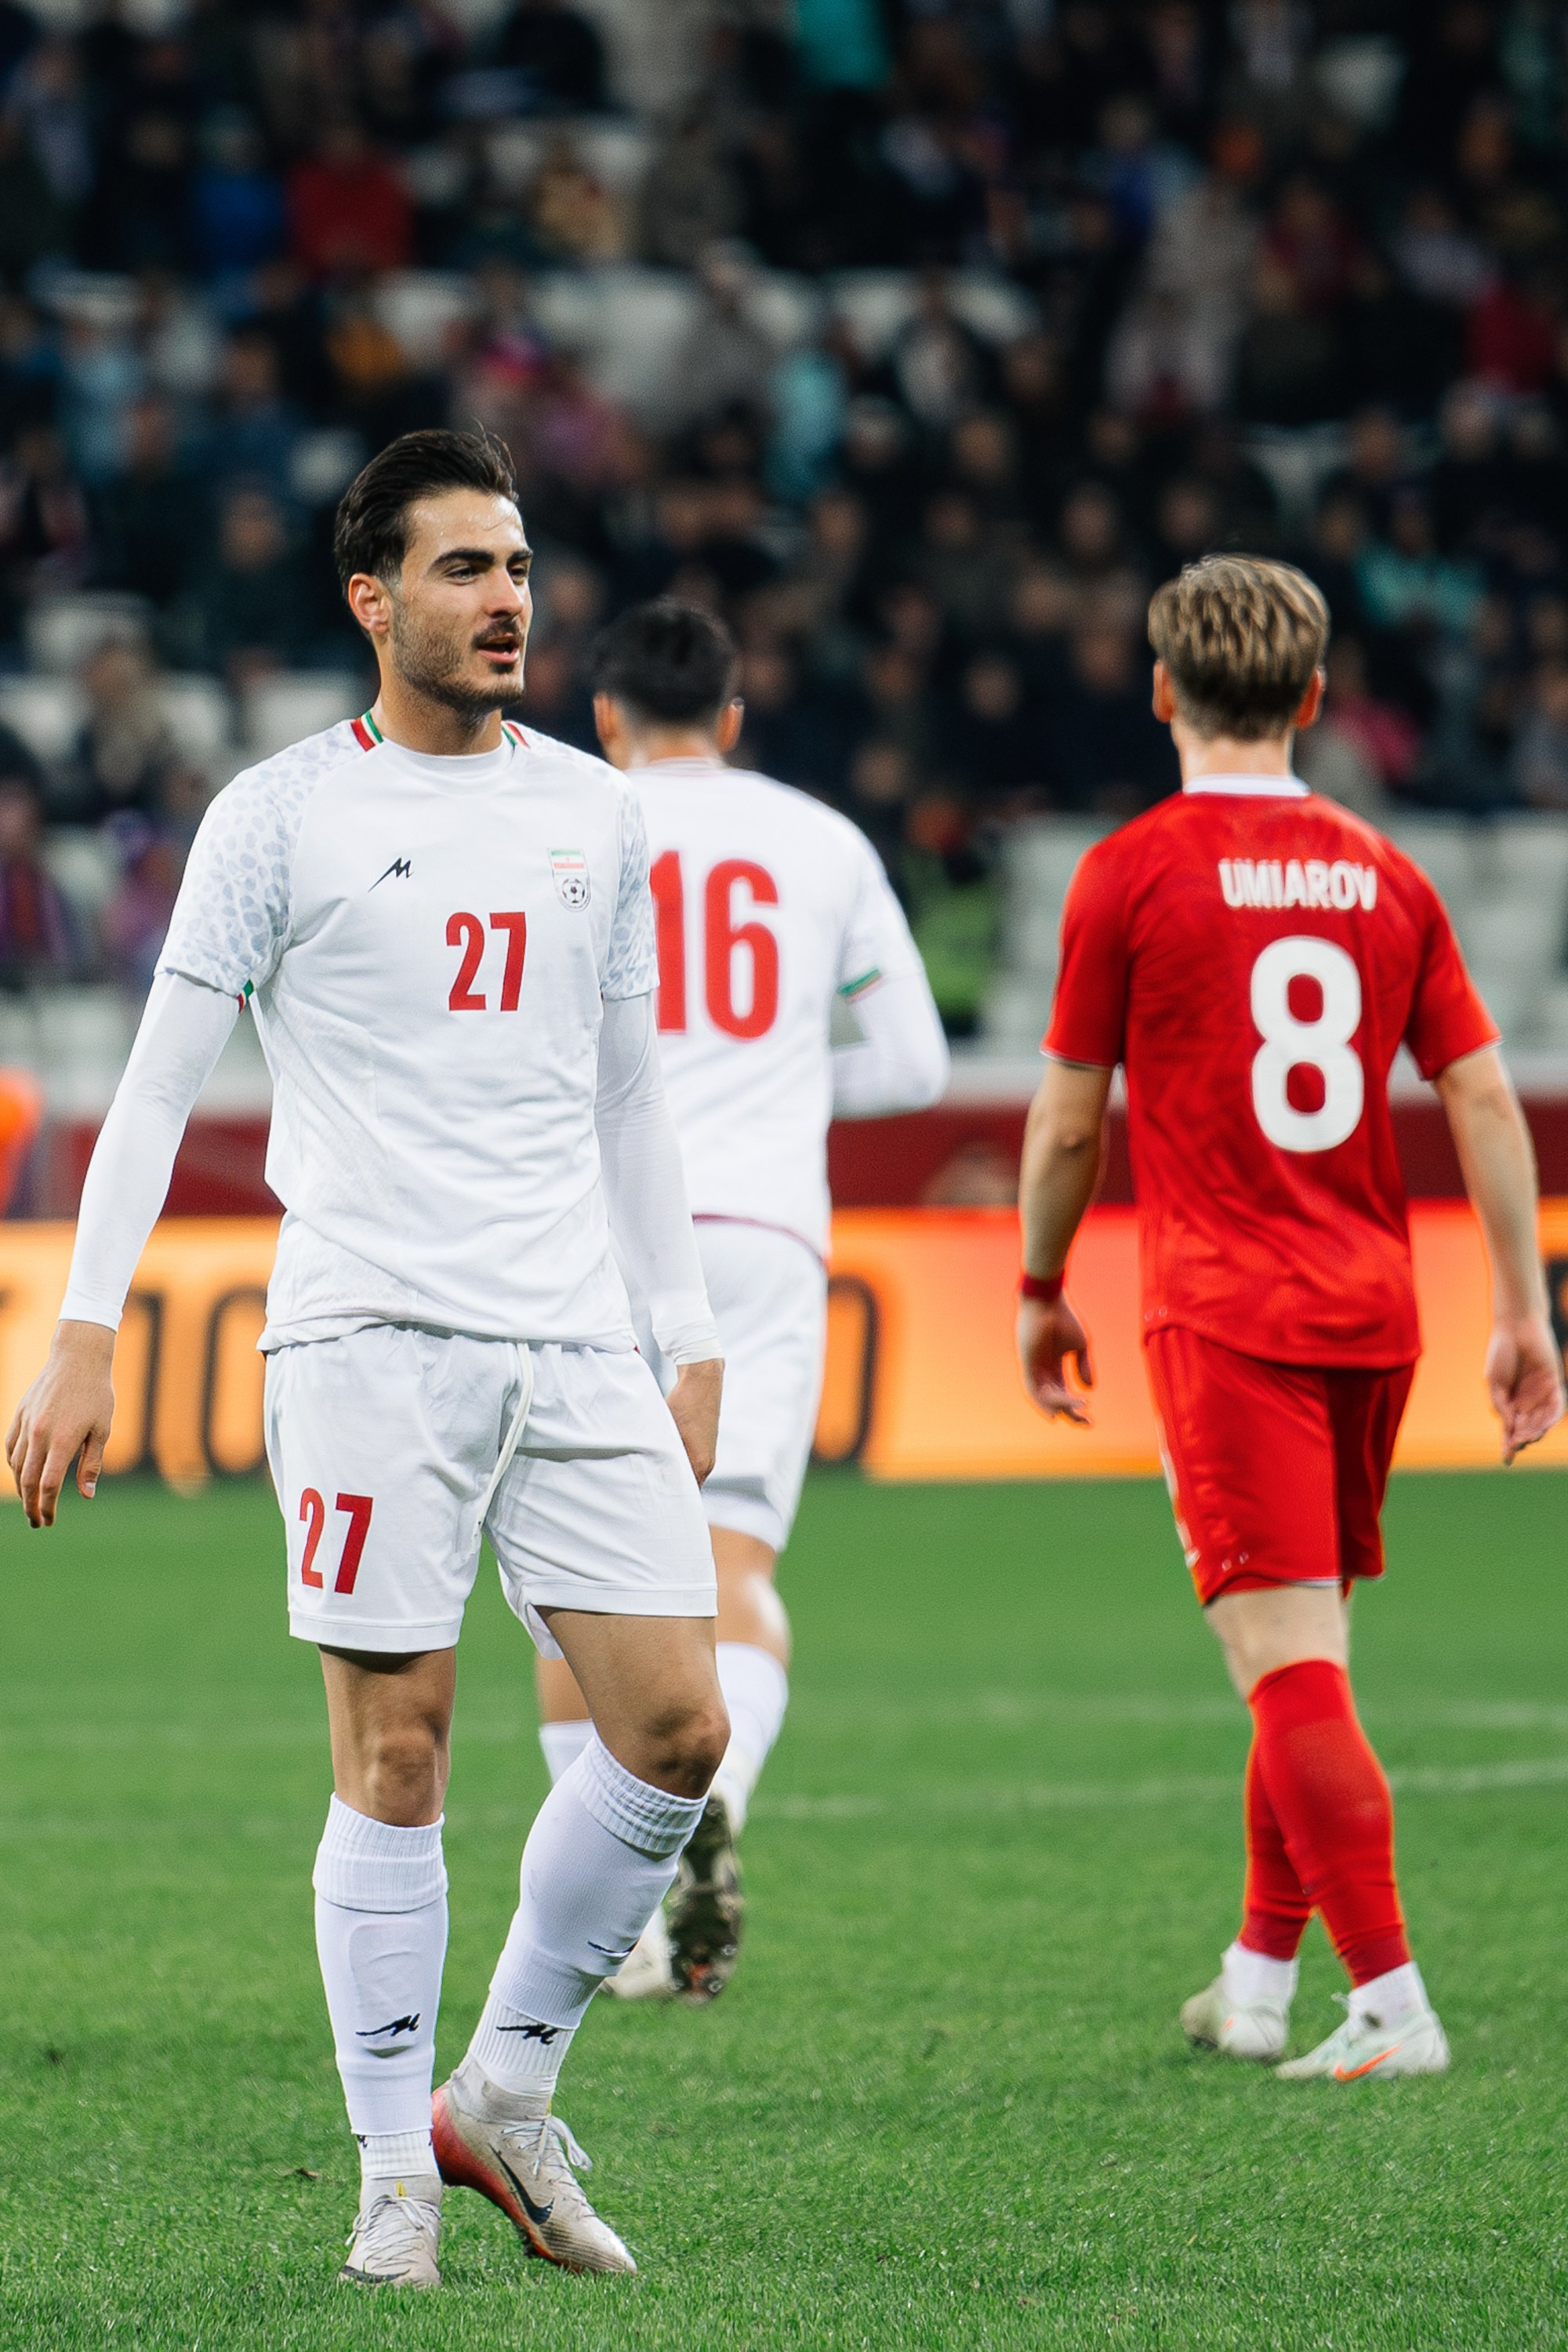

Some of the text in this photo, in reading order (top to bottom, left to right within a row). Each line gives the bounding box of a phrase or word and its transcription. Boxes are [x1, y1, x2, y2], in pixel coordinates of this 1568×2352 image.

[1218, 858, 1377, 912] UMIAROV
[446, 912, 527, 1011] 27
[651, 850, 779, 1040] 16
[1250, 935, 1364, 1153] 8
[299, 1487, 373, 1595] 27
